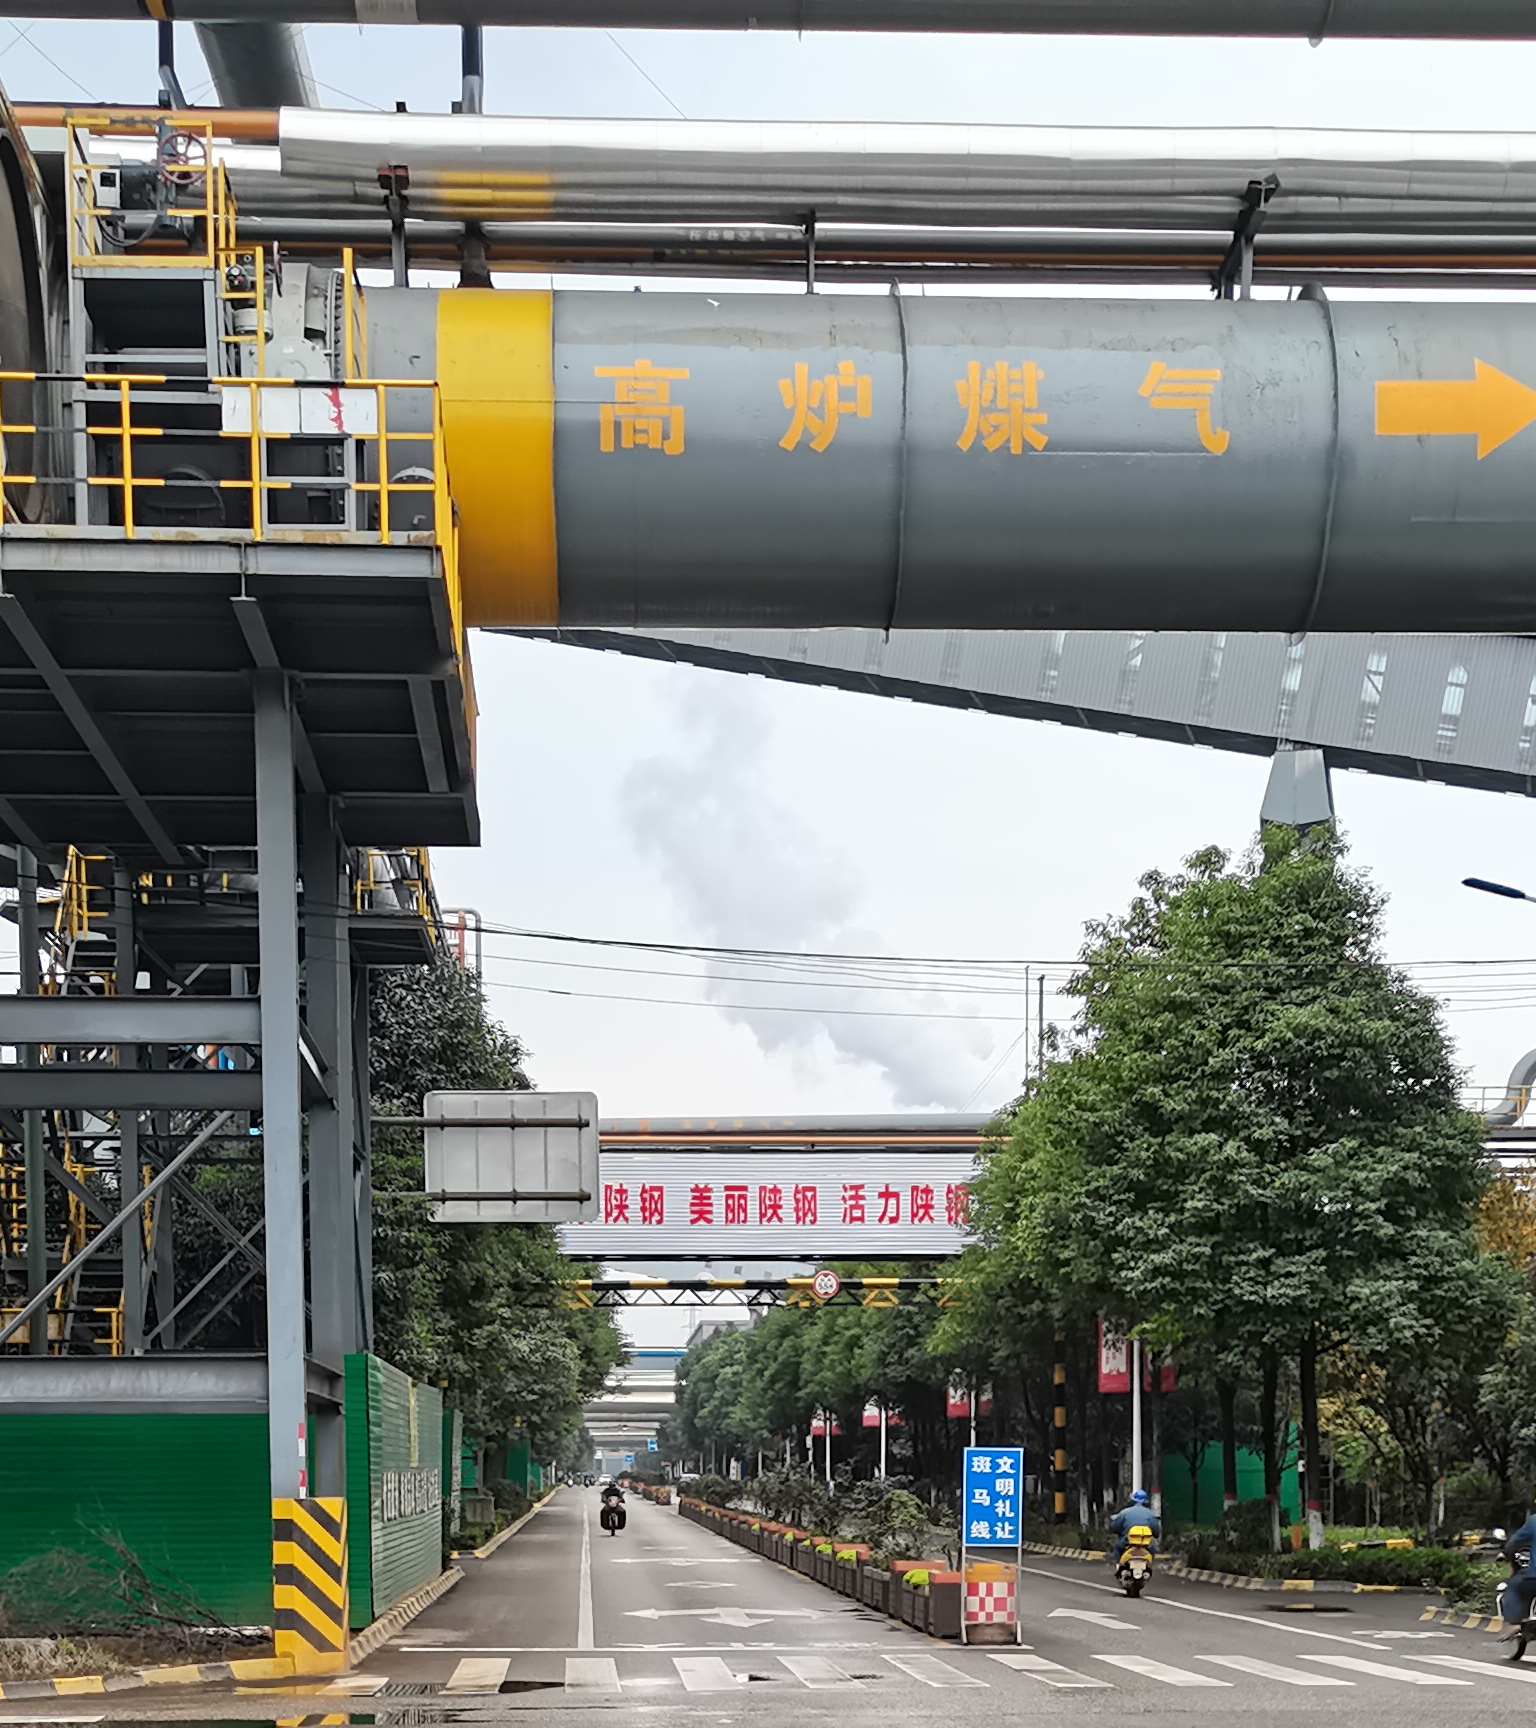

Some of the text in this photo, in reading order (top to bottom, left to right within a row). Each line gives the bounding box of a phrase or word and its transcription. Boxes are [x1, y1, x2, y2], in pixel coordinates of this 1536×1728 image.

[594, 359, 1231, 456] 高炉煤气
[574, 1183, 969, 1226] 陕钢 美丽陕钢 活力陕钢
[970, 1456, 992, 1539] 斑马线
[993, 1456, 1016, 1539] 文明礼让
